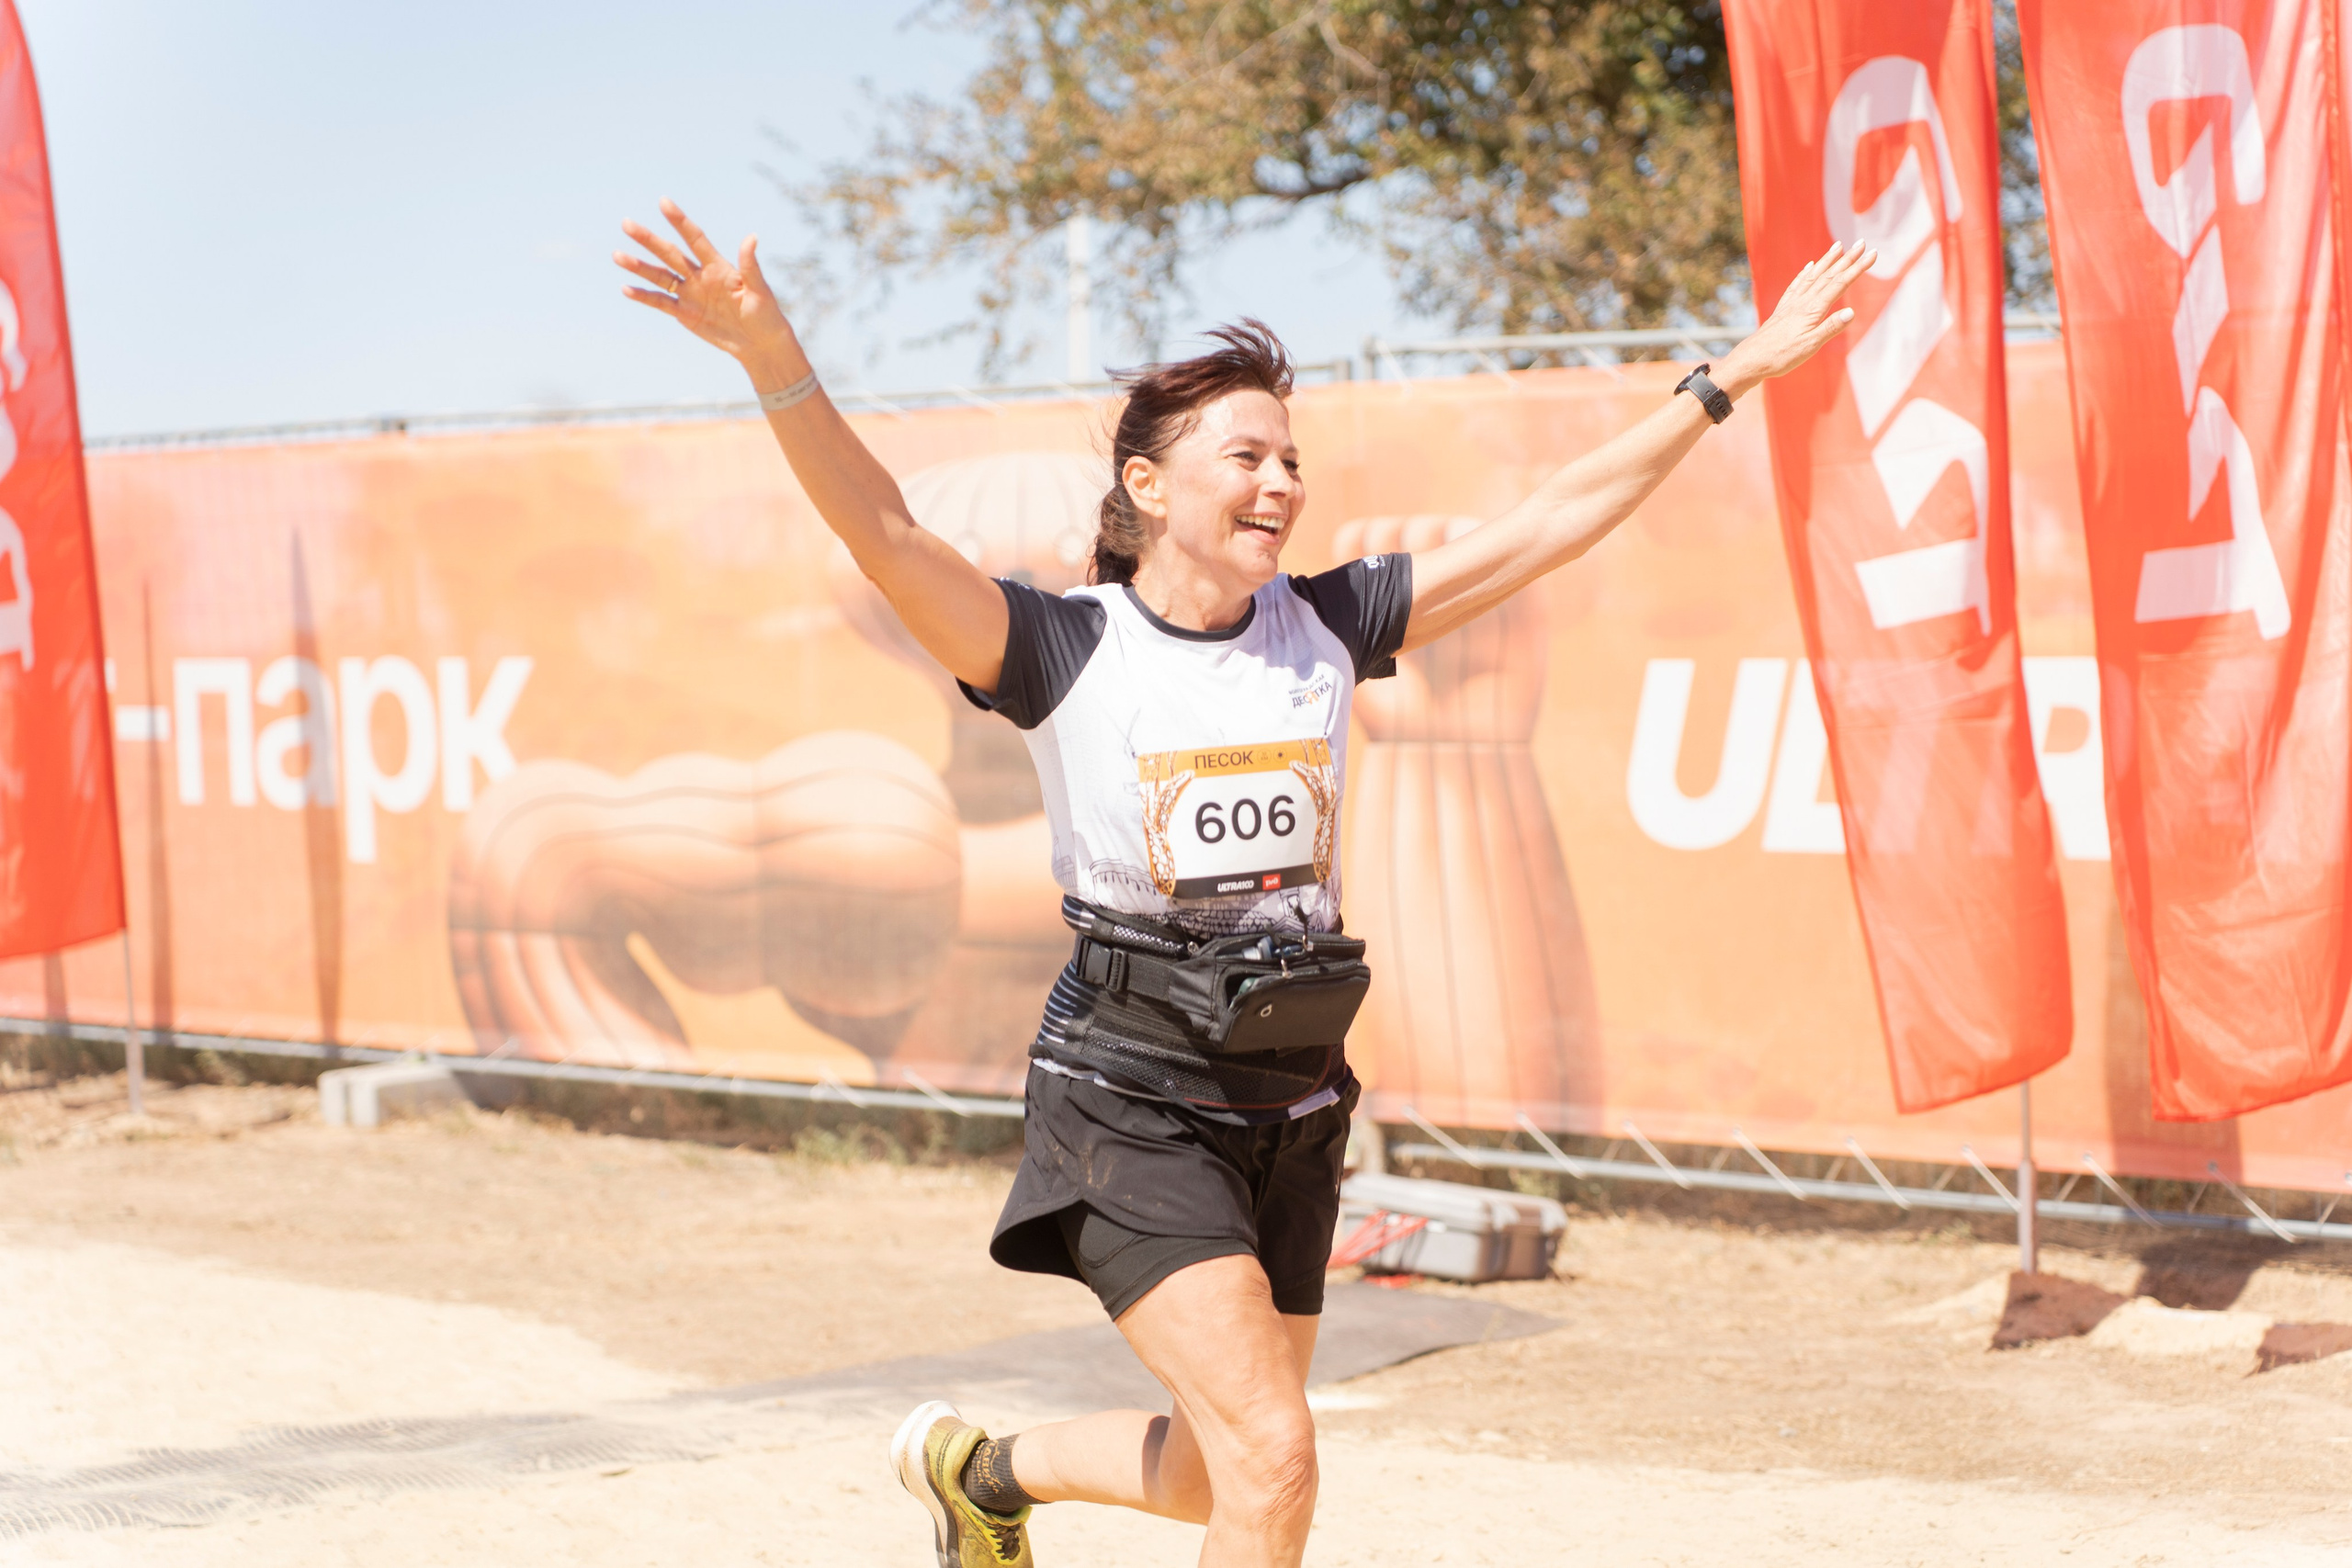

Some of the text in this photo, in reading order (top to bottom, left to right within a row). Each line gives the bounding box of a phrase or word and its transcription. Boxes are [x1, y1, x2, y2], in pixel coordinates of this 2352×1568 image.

[104, 654, 534, 863] -парк
[1194, 750, 1253, 769] ПЕСОК
[1195, 795, 1295, 843] 606
